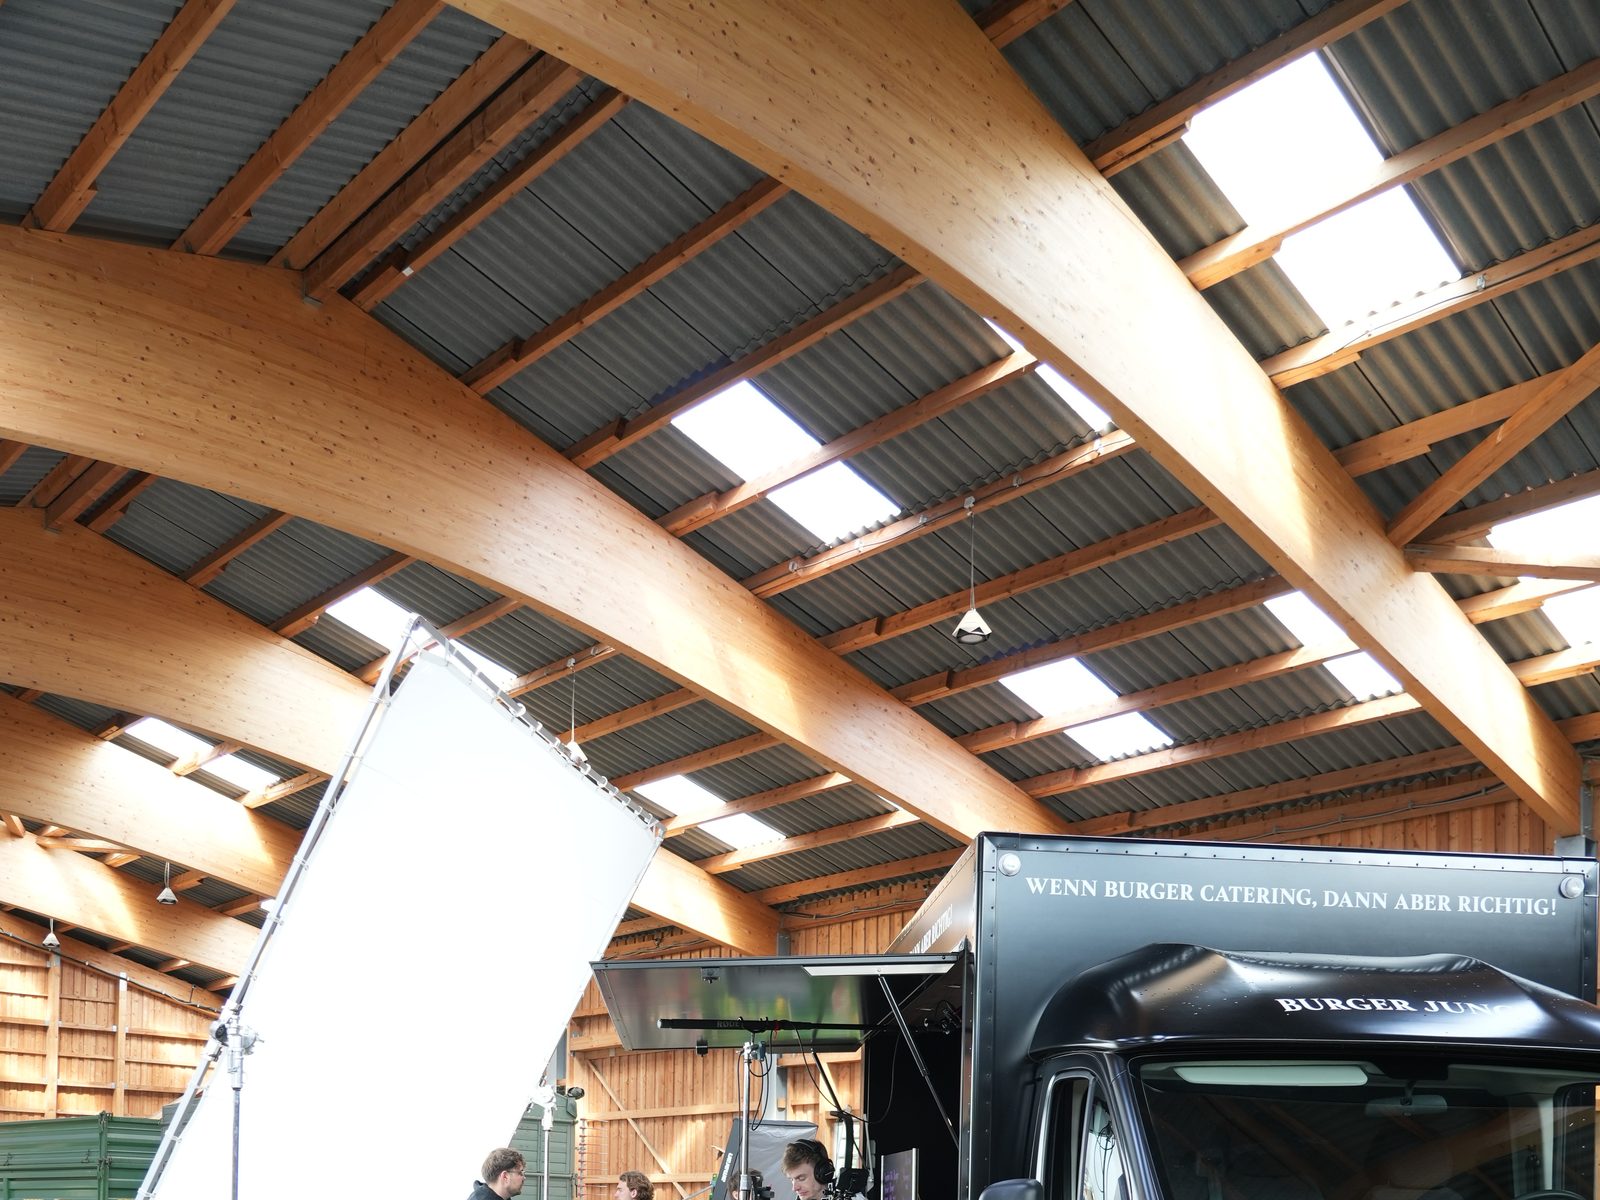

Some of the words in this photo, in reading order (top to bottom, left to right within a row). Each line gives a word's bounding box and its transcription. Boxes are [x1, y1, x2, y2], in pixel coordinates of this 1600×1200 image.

[1025, 877, 1097, 897] WENN
[1104, 880, 1194, 901] BURGER
[1200, 885, 1317, 908] CATERING,
[1323, 890, 1388, 910] DANN
[1394, 893, 1451, 912] ABER
[1457, 895, 1557, 916] RICHTIG!
[1274, 998, 1418, 1012] BURGER
